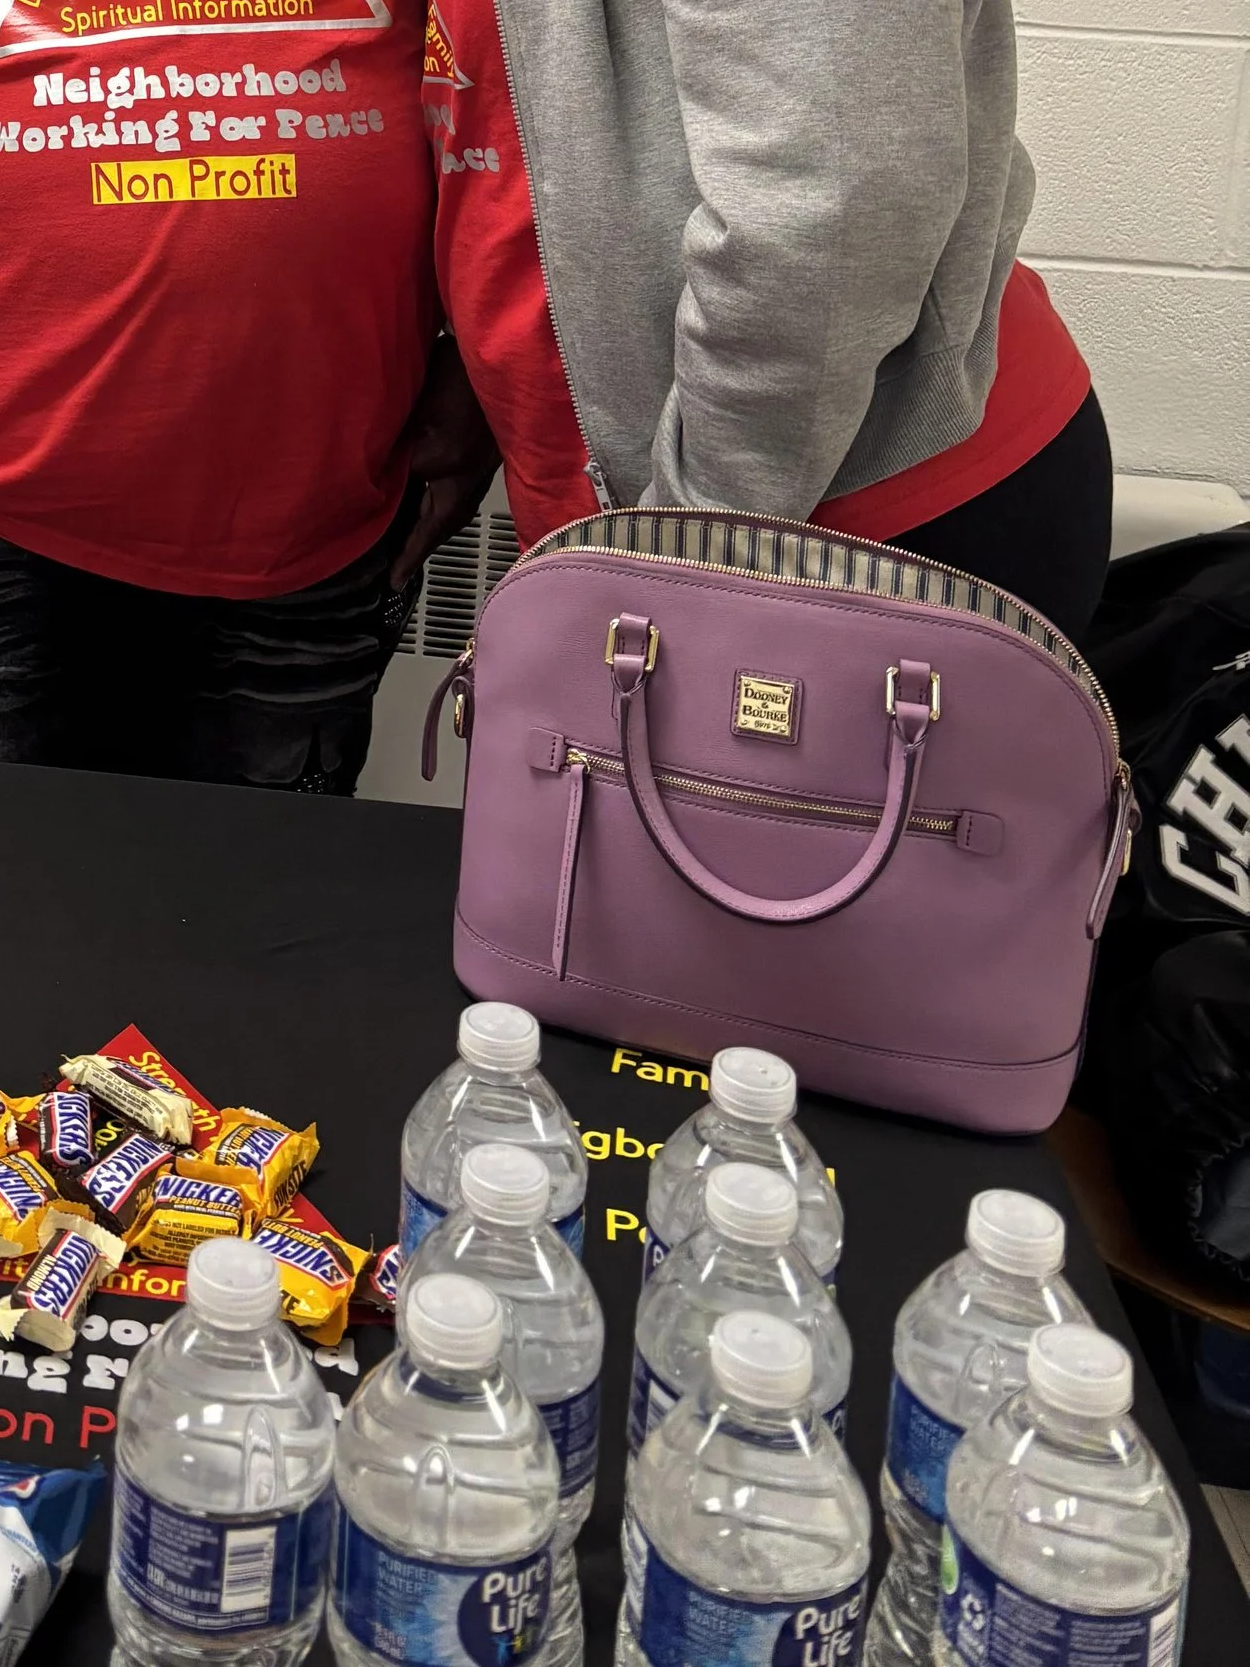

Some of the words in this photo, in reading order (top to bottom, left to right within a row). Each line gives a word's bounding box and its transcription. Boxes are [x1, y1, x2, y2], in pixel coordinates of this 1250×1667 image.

[33, 59, 347, 110] Neighborhood
[188, 109, 266, 142] For
[275, 107, 385, 140] Peace
[92, 162, 174, 202] Non
[189, 158, 293, 199] Profit
[170, 1195, 207, 1206] PEANUT
[289, 1229, 322, 1249] PEANUT
[26, 1254, 57, 1291] ALMOND
[482, 1557, 547, 1604] Pure
[490, 1591, 540, 1635] Life
[794, 1596, 861, 1640] Pure
[804, 1630, 852, 1667] Life
